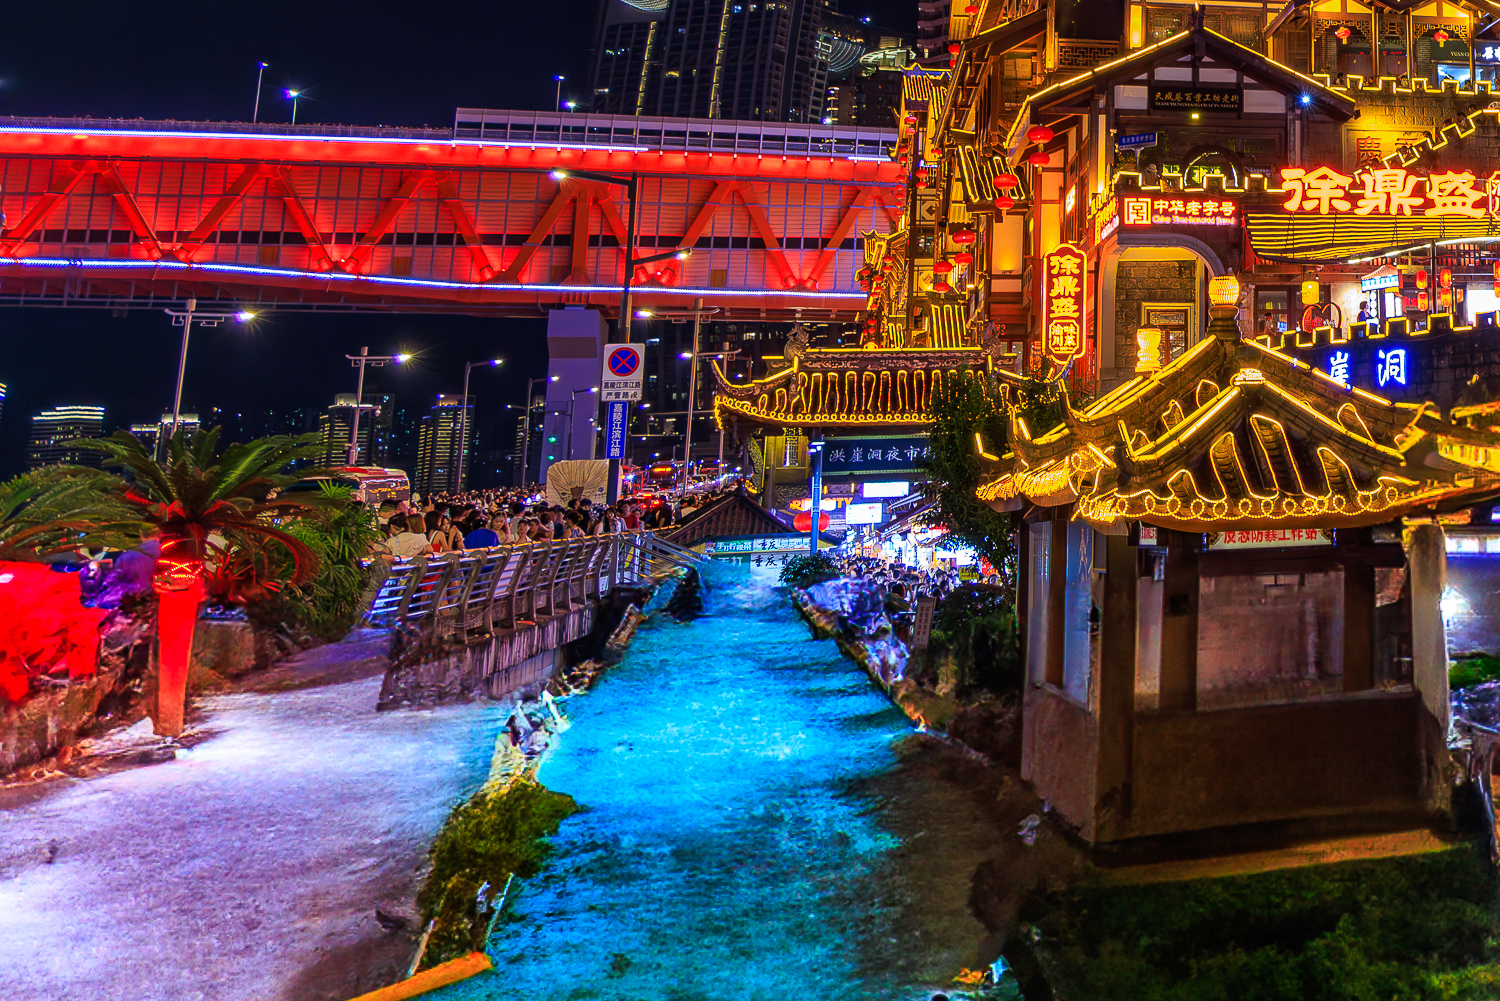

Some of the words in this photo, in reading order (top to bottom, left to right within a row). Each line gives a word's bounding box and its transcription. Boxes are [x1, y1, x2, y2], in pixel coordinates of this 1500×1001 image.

[1281, 166, 1486, 219] 徐鼎盛
[1153, 199, 1236, 217] 中华老字号
[1049, 254, 1081, 318] 徐鼎盛
[604, 381, 641, 390] 嘉陵江滨江路
[605, 391, 638, 400] 严管路段
[610, 403, 623, 457] 嘉陵江滨江路
[1223, 529, 1318, 544] 反恐防暴工作站
